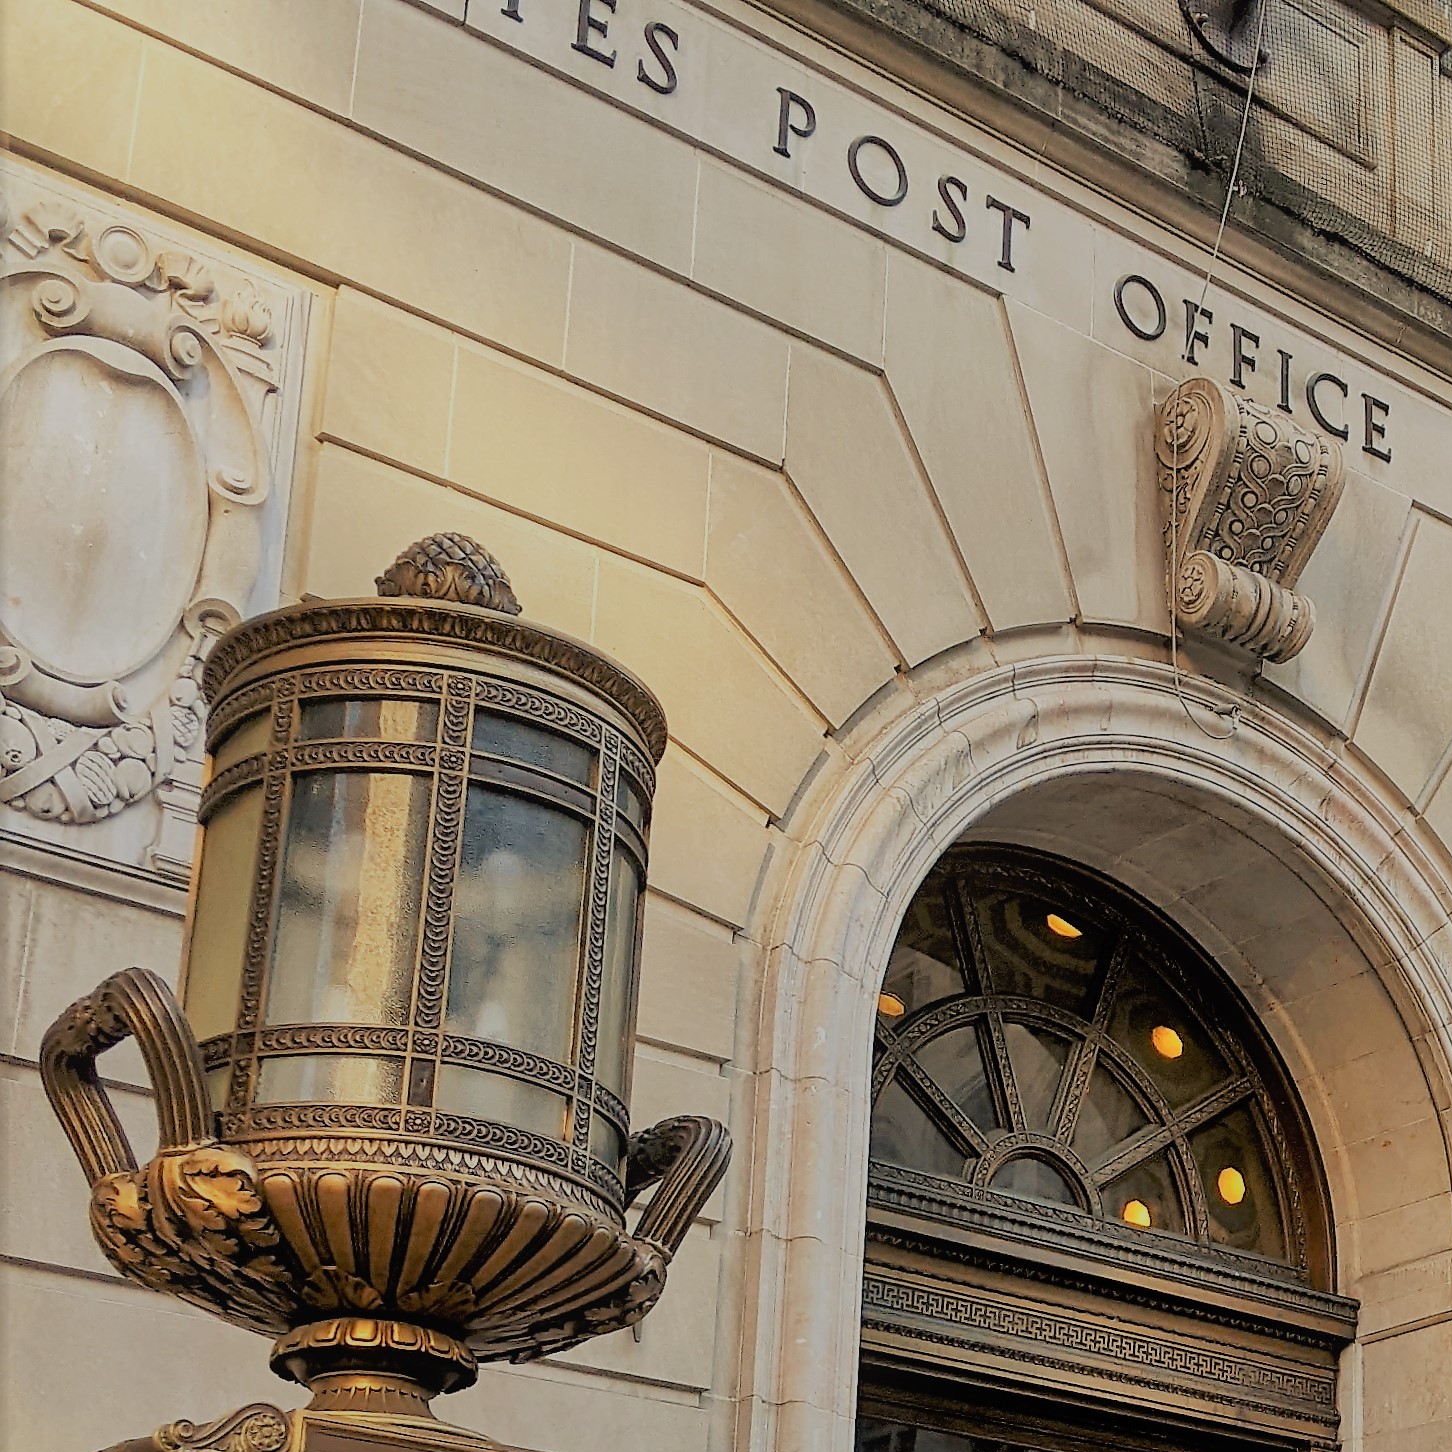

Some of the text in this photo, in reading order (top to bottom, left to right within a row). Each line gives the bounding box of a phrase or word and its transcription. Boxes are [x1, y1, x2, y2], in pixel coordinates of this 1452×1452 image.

[501, 0, 679, 95] ES
[773, 86, 1031, 274] POST
[1113, 273, 1392, 463] OFFICE
